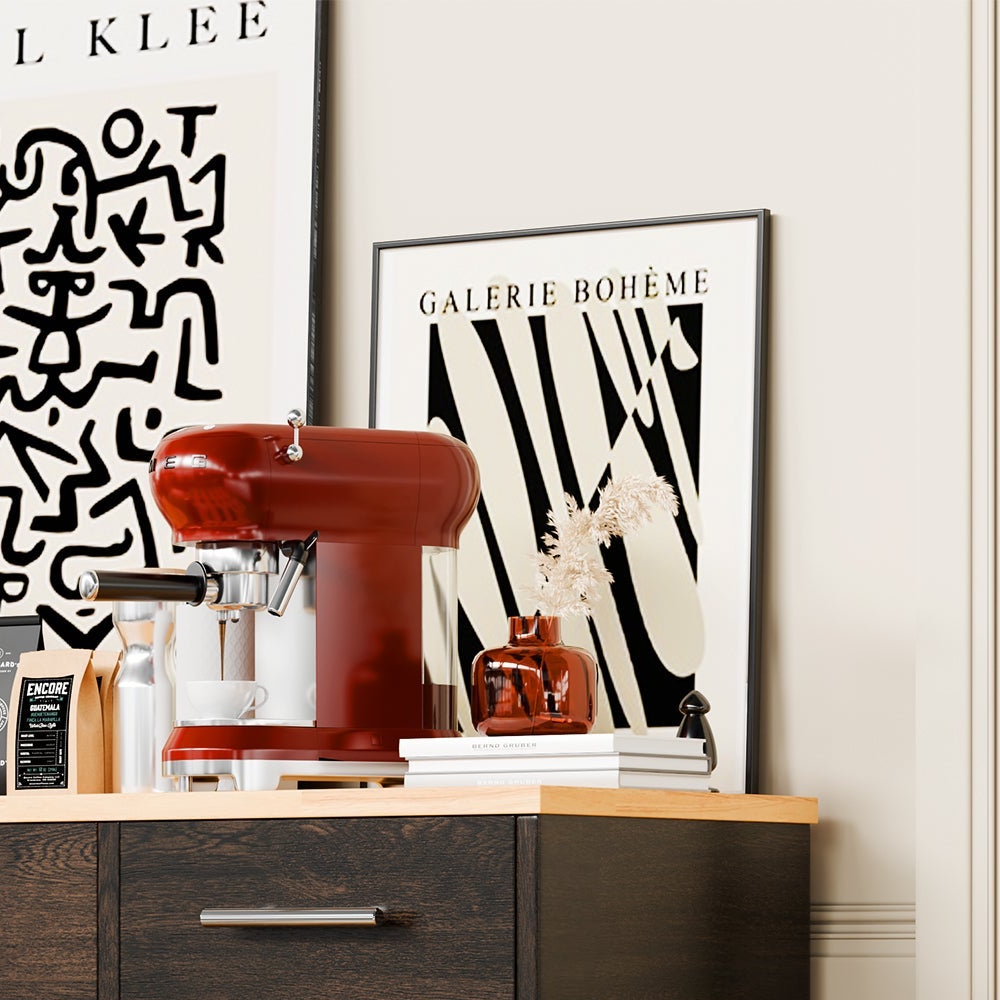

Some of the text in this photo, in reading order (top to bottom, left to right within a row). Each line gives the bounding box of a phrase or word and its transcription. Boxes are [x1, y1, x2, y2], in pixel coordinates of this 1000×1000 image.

[88, 0, 269, 57] KLEE
[419, 266, 709, 316] GALERIE BOHÈME
[26, 681, 70, 696] ENCORE
